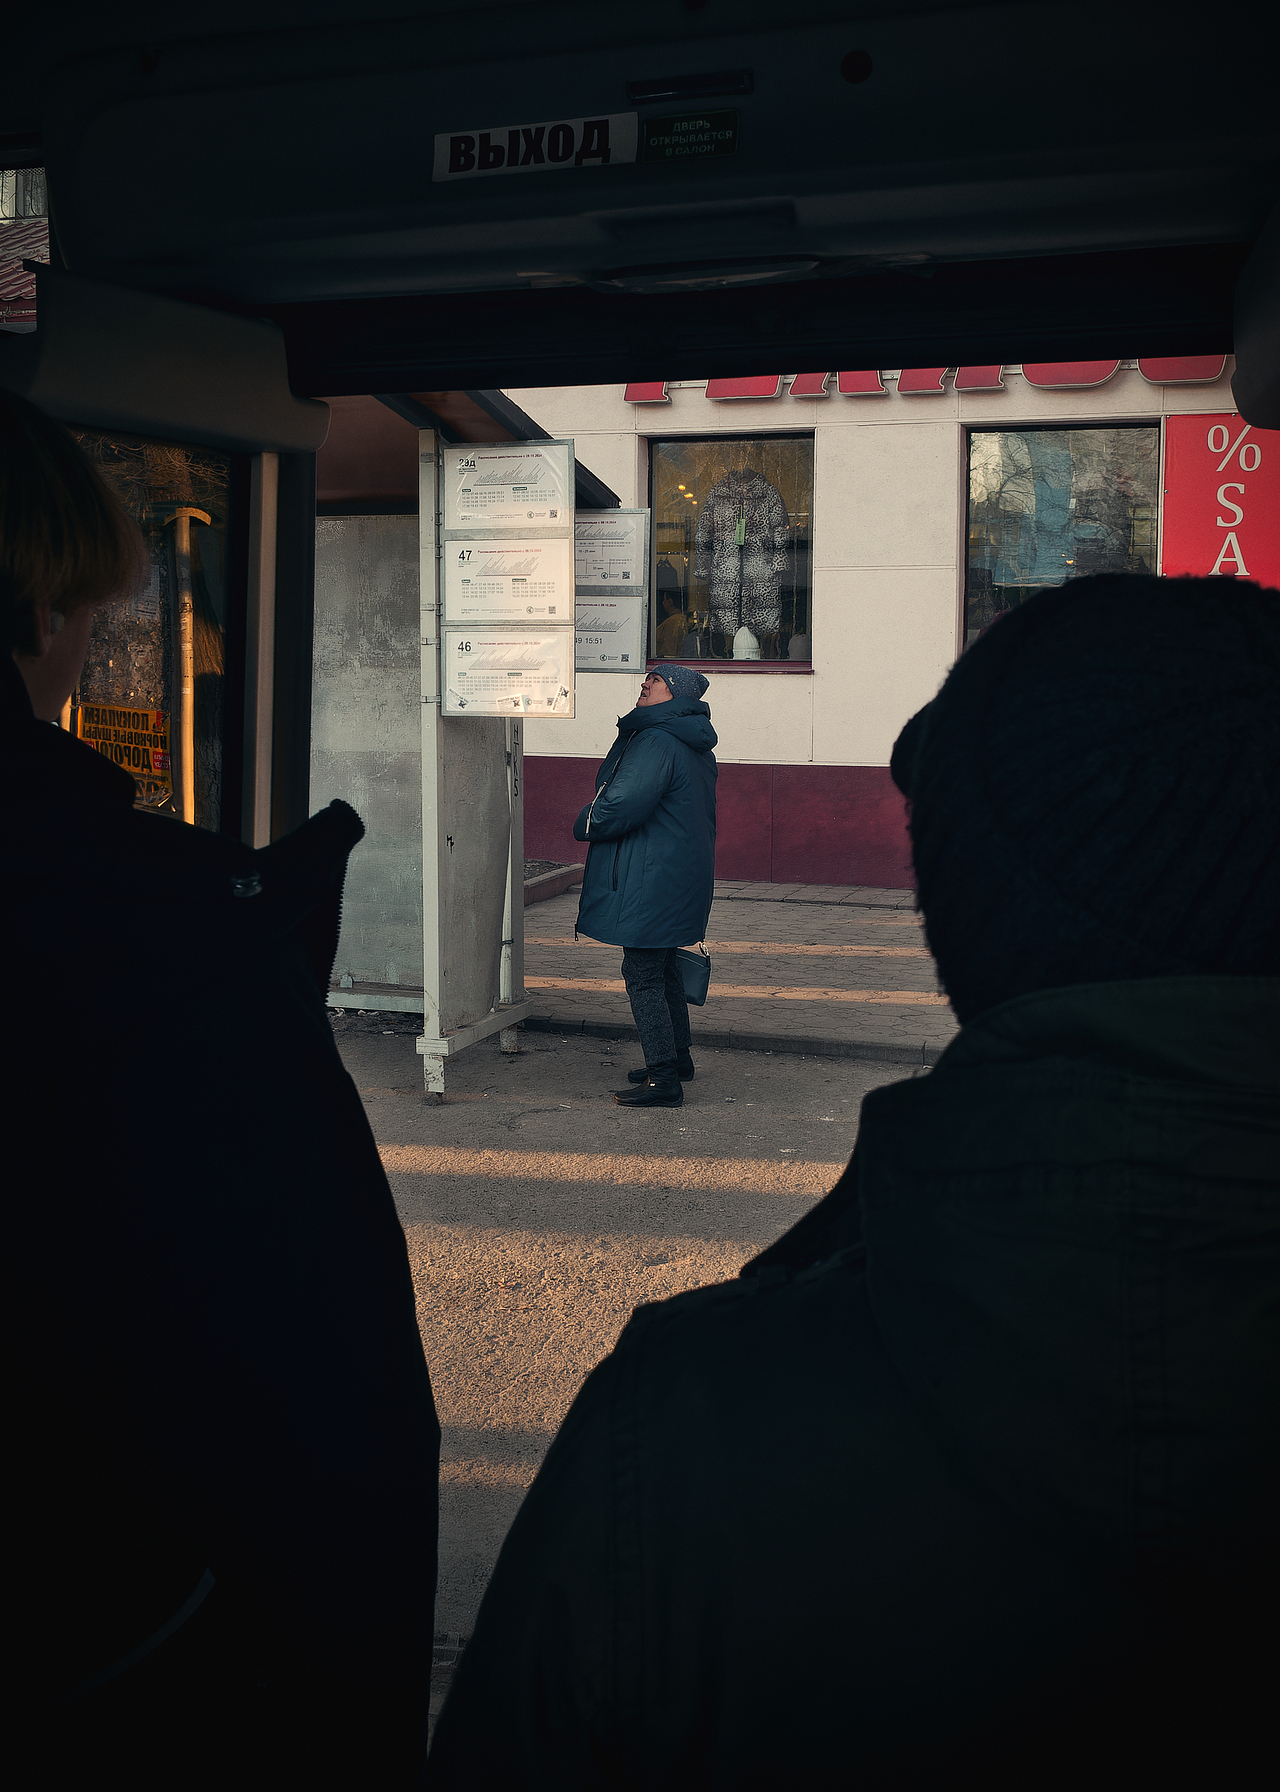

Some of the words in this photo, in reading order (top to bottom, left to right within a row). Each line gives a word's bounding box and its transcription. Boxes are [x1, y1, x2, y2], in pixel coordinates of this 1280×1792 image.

[672, 119, 711, 133] ДВЕРЬ
[649, 130, 733, 146] ОТКРЫВАЕТСЯ
[448, 119, 611, 174] ВЫХОД
[665, 147, 673, 157] В
[675, 144, 715, 156] САЛОН
[458, 550, 473, 561] 47
[457, 641, 472, 652] 46
[585, 637, 603, 645] 15:51
